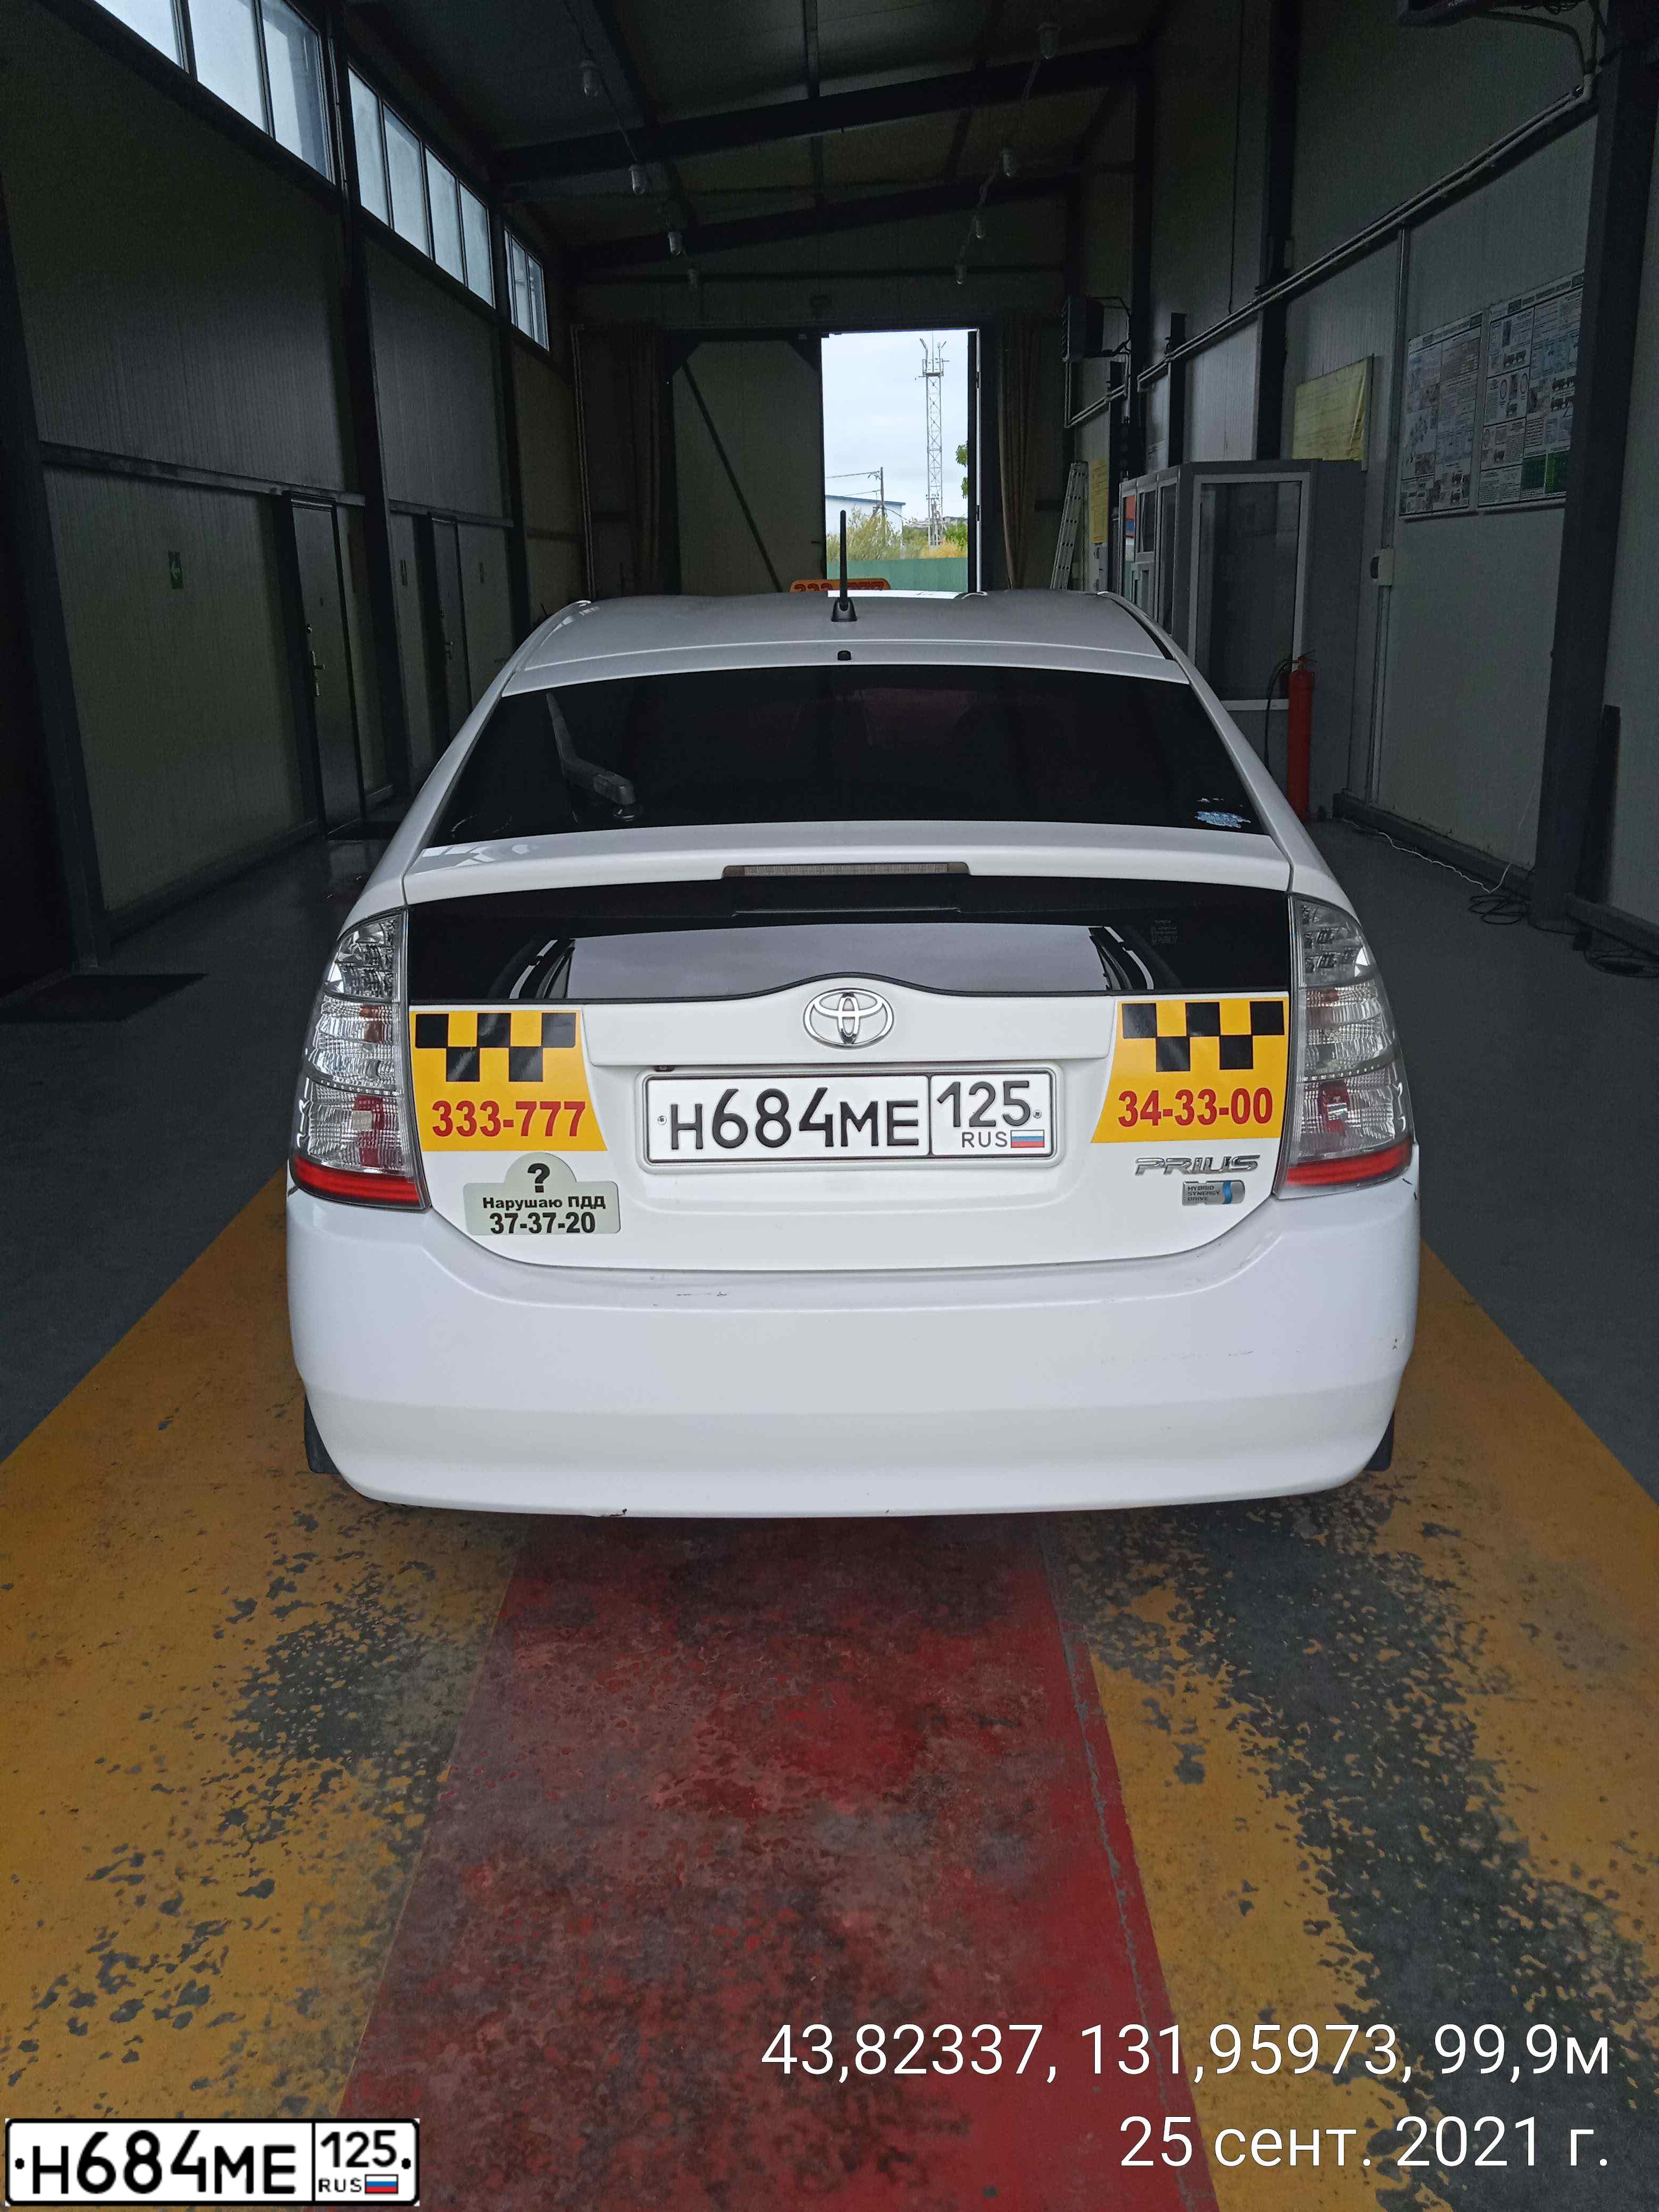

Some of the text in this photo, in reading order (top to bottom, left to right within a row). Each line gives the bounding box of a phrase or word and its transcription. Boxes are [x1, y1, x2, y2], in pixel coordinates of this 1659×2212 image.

[937, 1080, 1031, 1128] 125
[1118, 1087, 1273, 1127] 34-33-00
[432, 1100, 586, 1137] 333-777
[962, 1131, 1008, 1149] RUS
[1135, 1154, 1261, 1176] PRIUS
[482, 1196, 606, 1211] Нарушаю ПДД
[489, 1211, 596, 1234] 37-37-20
